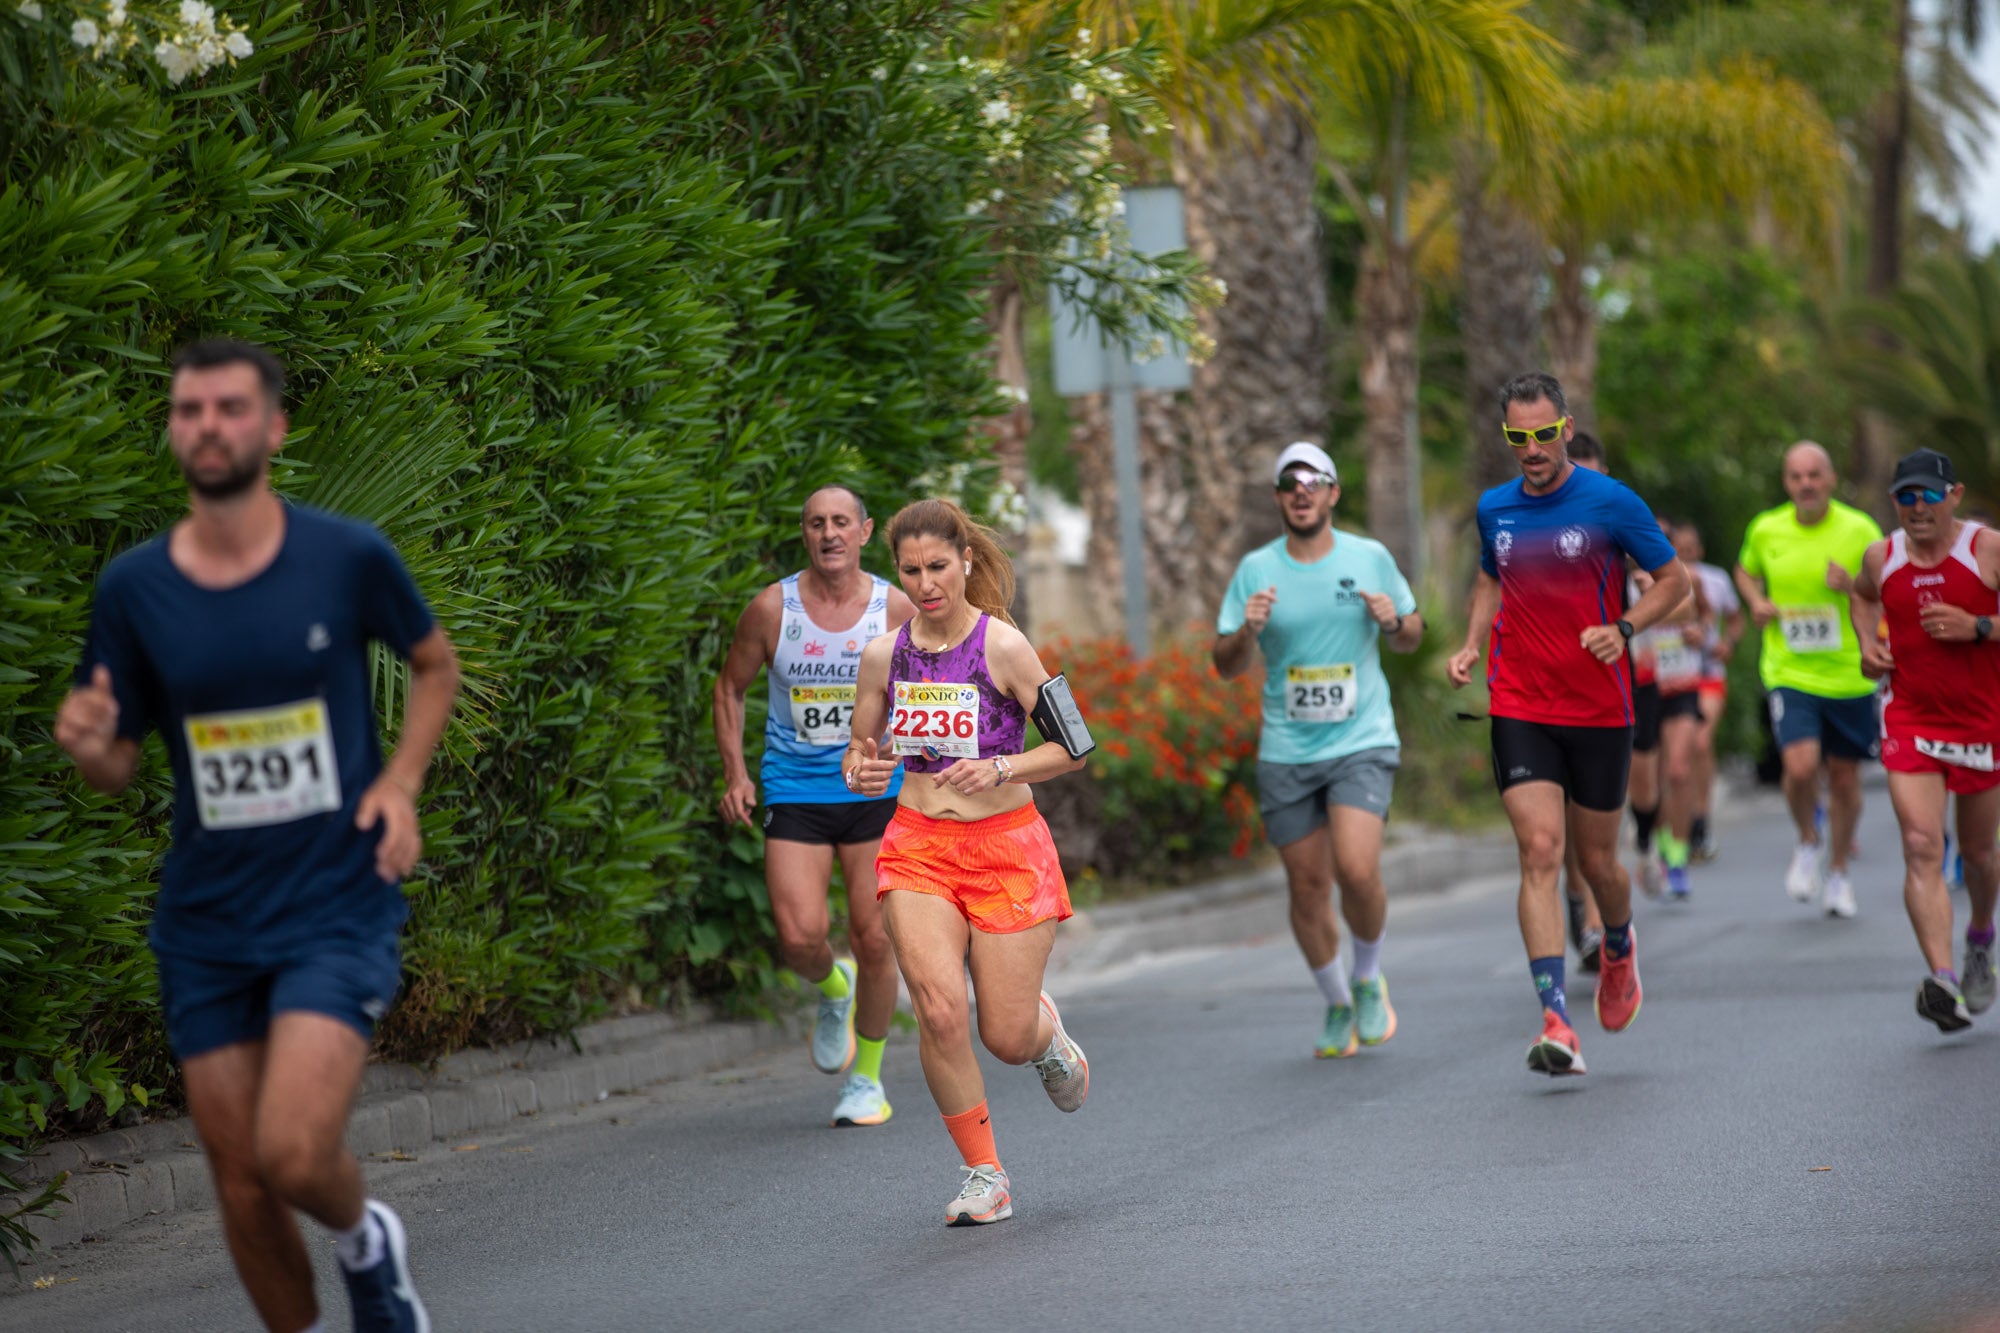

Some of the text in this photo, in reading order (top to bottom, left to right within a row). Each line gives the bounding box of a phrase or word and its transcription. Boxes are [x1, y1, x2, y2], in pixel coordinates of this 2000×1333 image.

[1294, 685, 1344, 707] 259
[804, 705, 854, 730] 847
[893, 708, 974, 739] 2236
[202, 743, 321, 798] 3291
